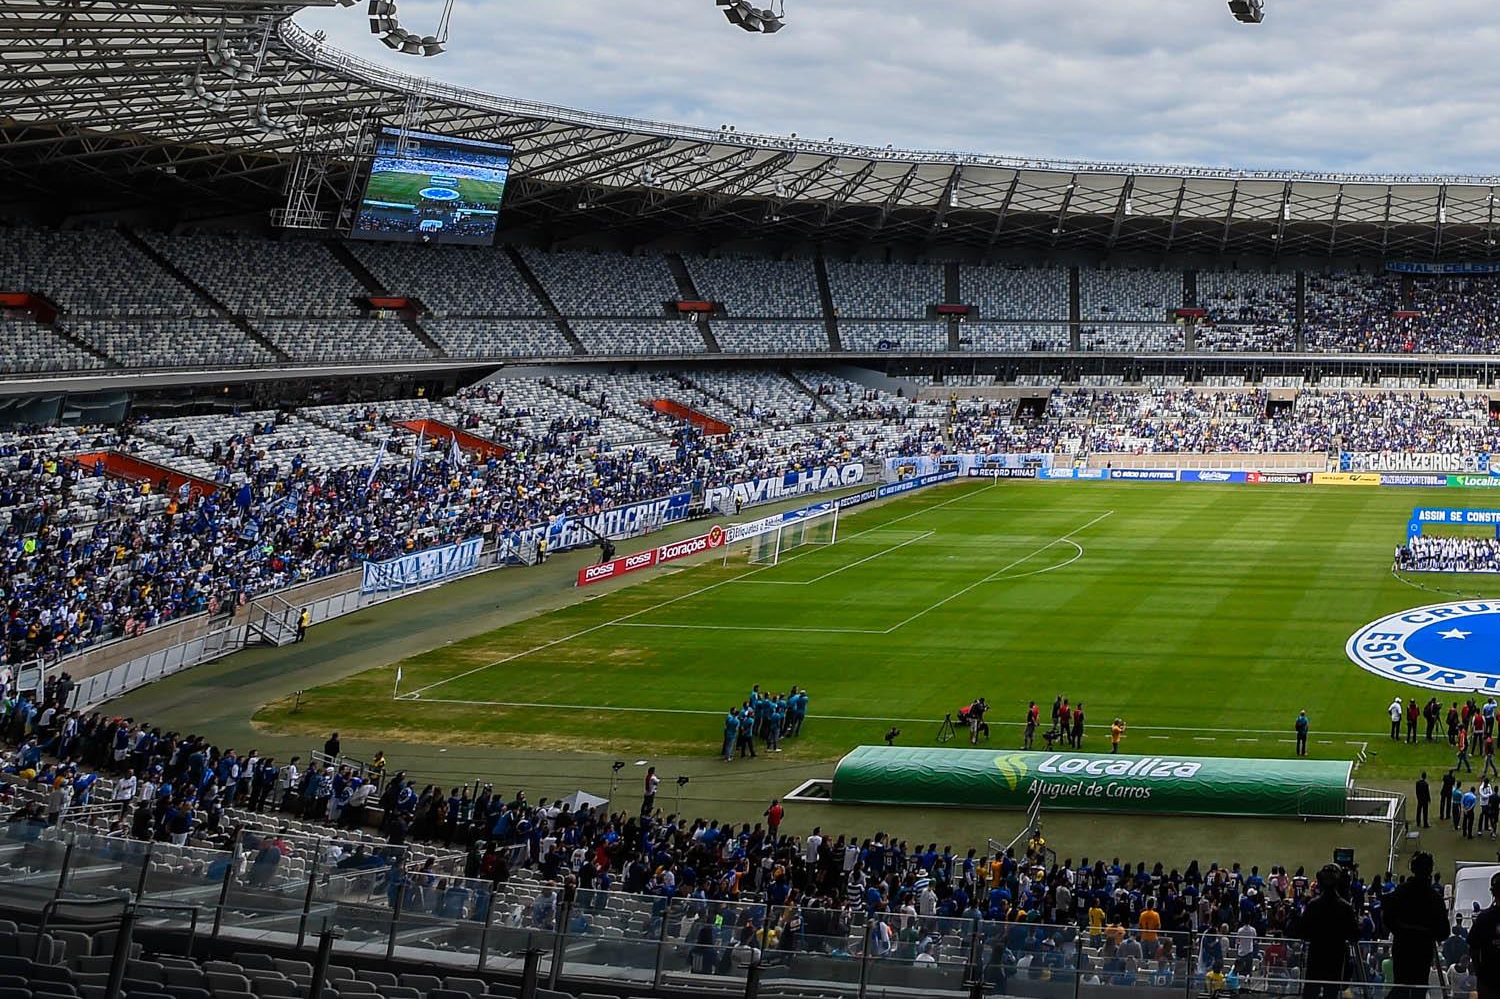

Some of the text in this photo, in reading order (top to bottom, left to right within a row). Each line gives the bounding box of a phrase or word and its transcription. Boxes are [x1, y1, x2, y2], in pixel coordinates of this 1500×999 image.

[1370, 453, 1461, 471] CACHAZEIROS
[979, 468, 1035, 478] RECORD MINAS
[1450, 511, 1463, 522] SE
[625, 553, 652, 567] ROSSI
[585, 562, 615, 579] ROSSI
[1038, 754, 1202, 778] Localiza
[1026, 779, 1151, 800] Aluguel de Carros
